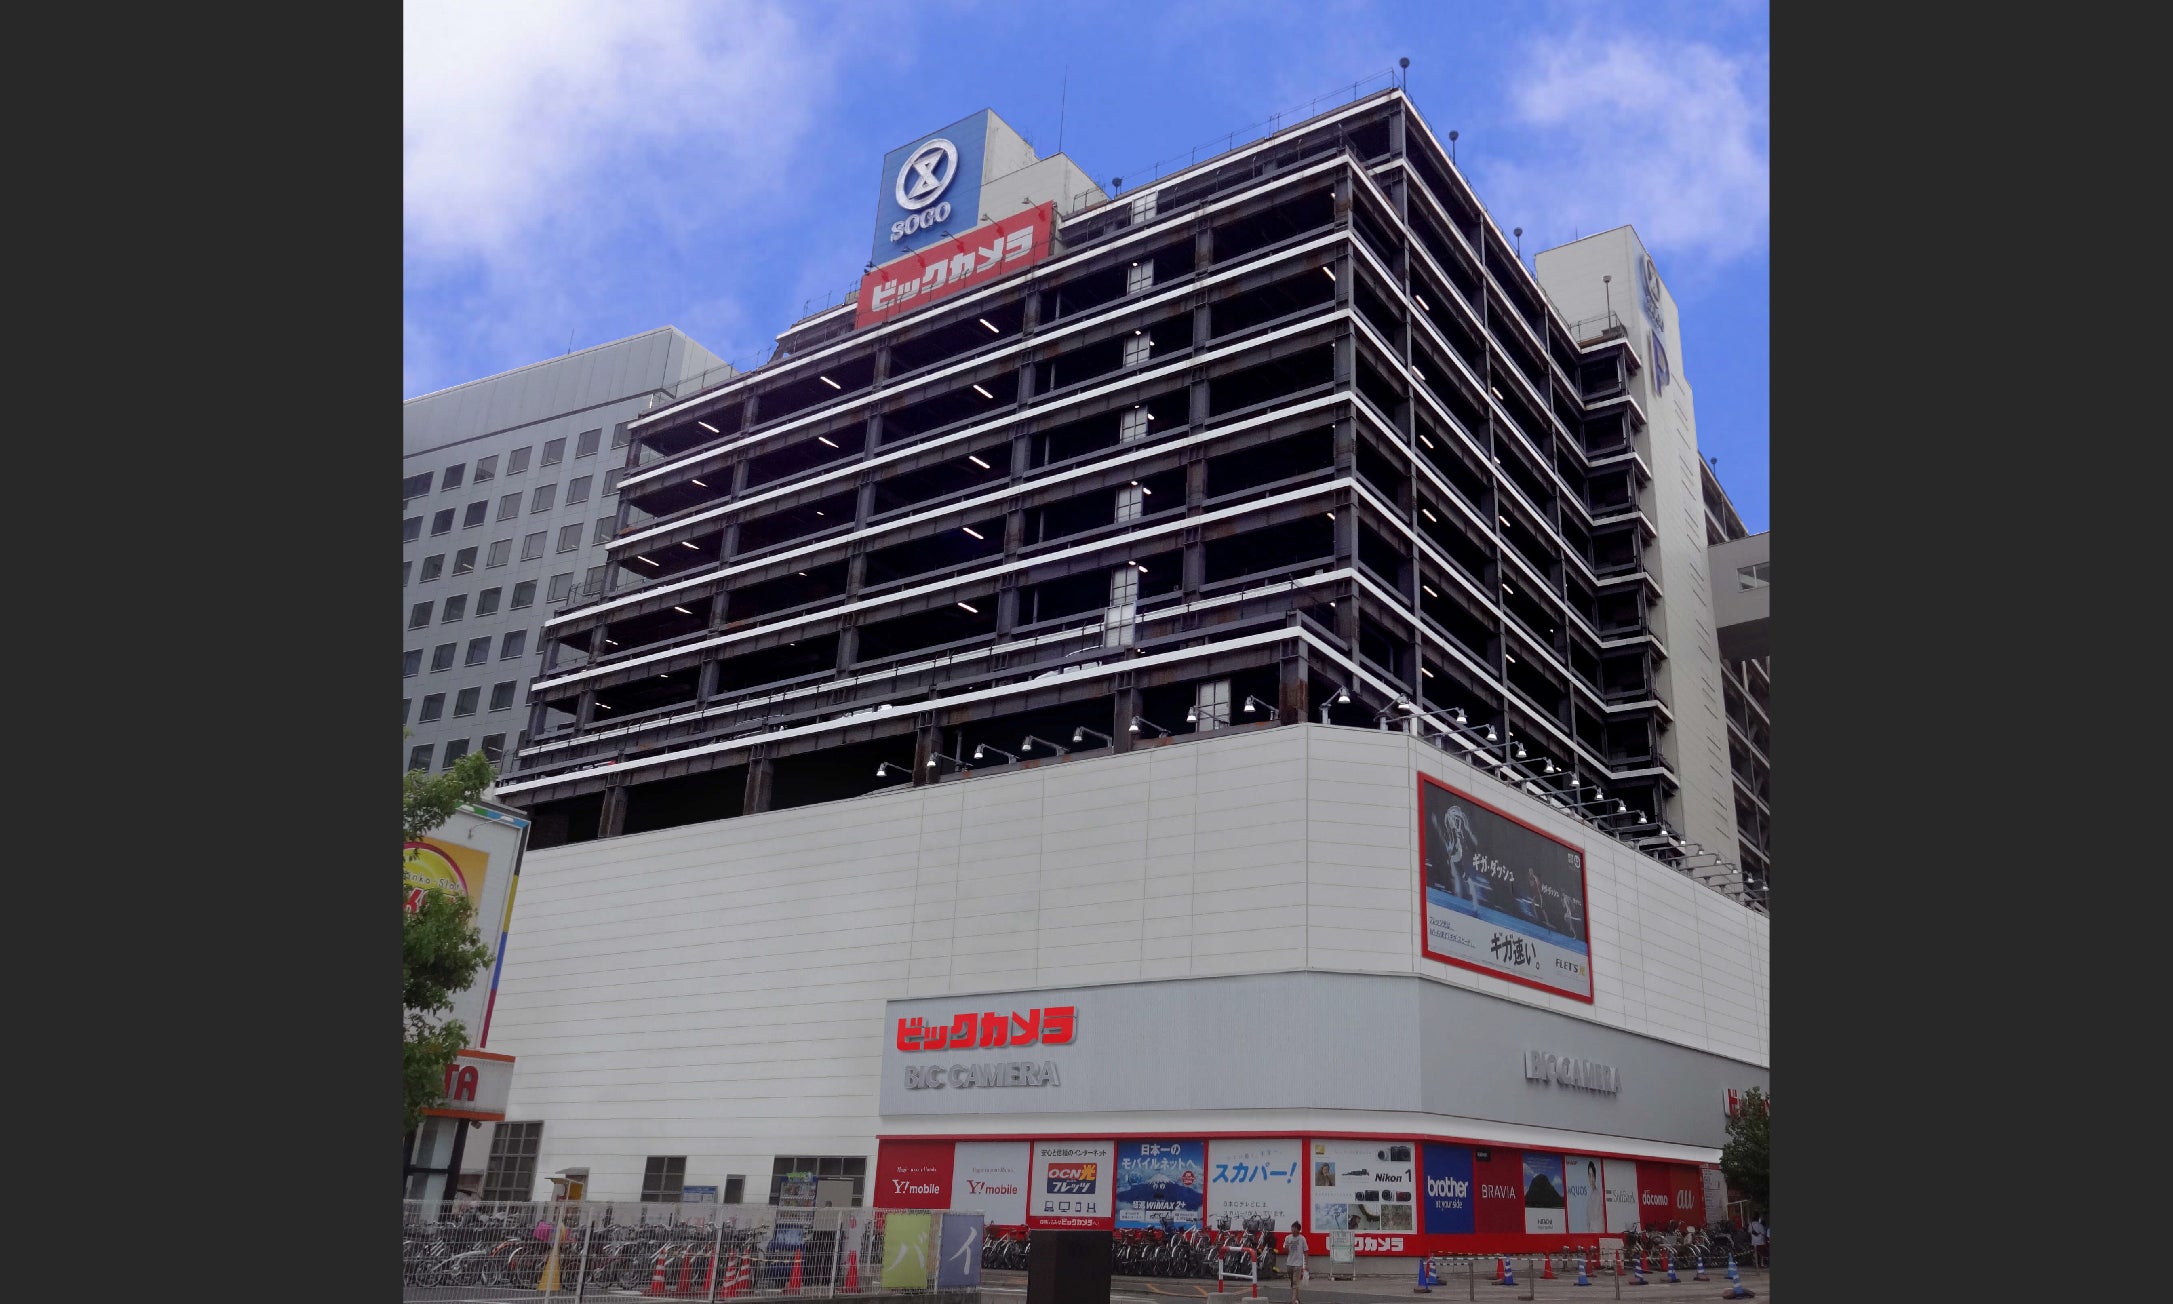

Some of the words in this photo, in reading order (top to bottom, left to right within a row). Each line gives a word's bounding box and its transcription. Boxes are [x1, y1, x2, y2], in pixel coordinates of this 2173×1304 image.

[890, 201, 952, 243] SOGO
[871, 225, 1034, 312] ビックカメラ
[896, 1005, 1077, 1052] ビックカメラ
[904, 1065, 946, 1090] BIC
[949, 1060, 1061, 1088] CAMERA
[1141, 1143, 1181, 1157] 日本一の
[1122, 1157, 1197, 1171] モバイルネットへ
[1375, 1173, 1402, 1183] Nikon
[1405, 1168, 1412, 1183] 1
[1052, 1181, 1091, 1193] フレッツ
[1427, 1175, 1469, 1198] brother
[1481, 1184, 1516, 1199] BRAVIA
[1642, 1190, 1669, 1206] docomo
[1676, 1188, 1695, 1209] au
